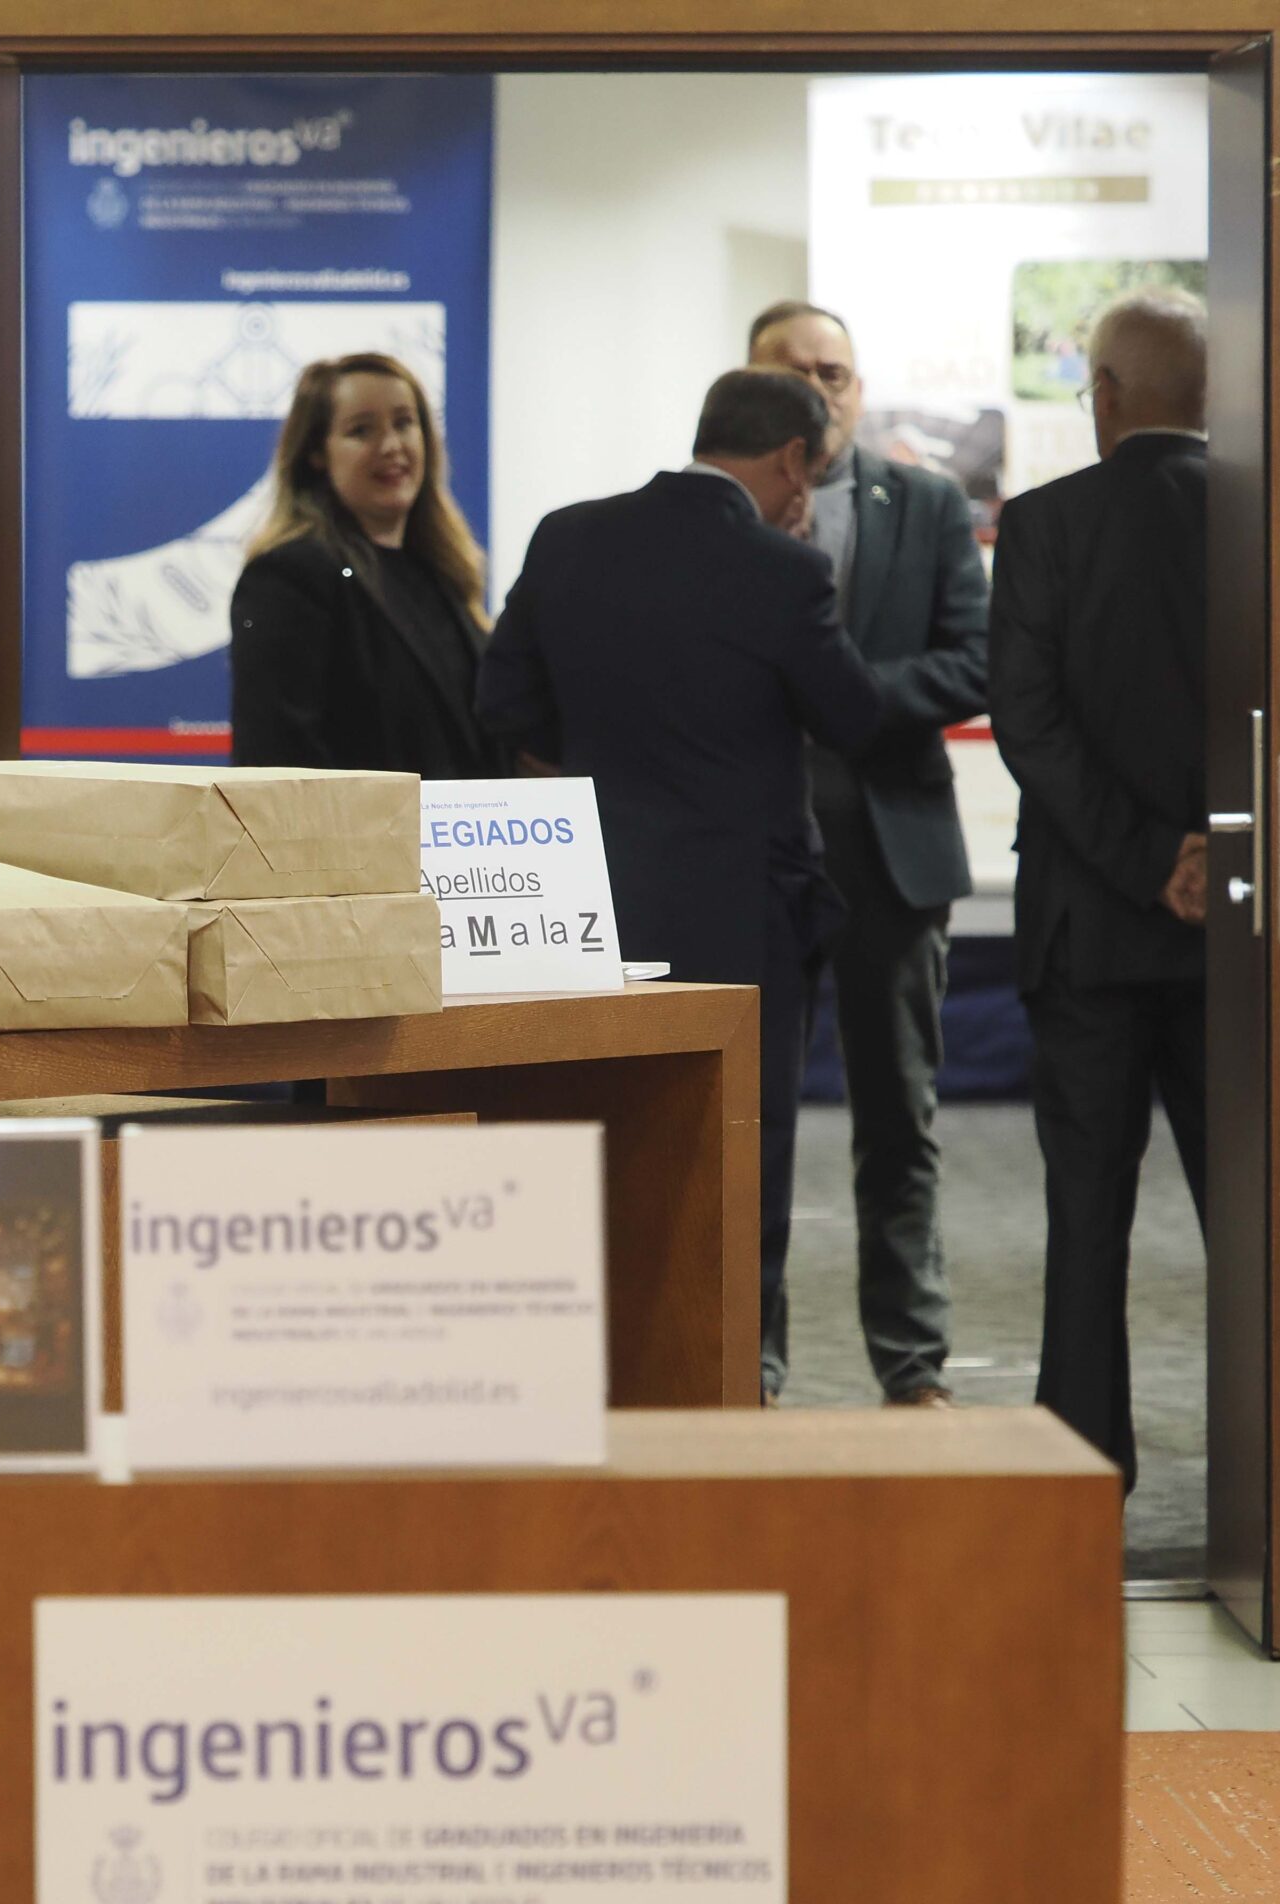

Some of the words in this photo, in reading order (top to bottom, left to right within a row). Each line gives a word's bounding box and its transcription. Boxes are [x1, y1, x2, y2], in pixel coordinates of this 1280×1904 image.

[420, 817, 575, 849] EGIADOS
[421, 866, 542, 901] Apellidos
[440, 924, 457, 948] a
[467, 915, 499, 948] M
[510, 921, 530, 946] a
[540, 913, 569, 945] la
[578, 912, 603, 944] Z
